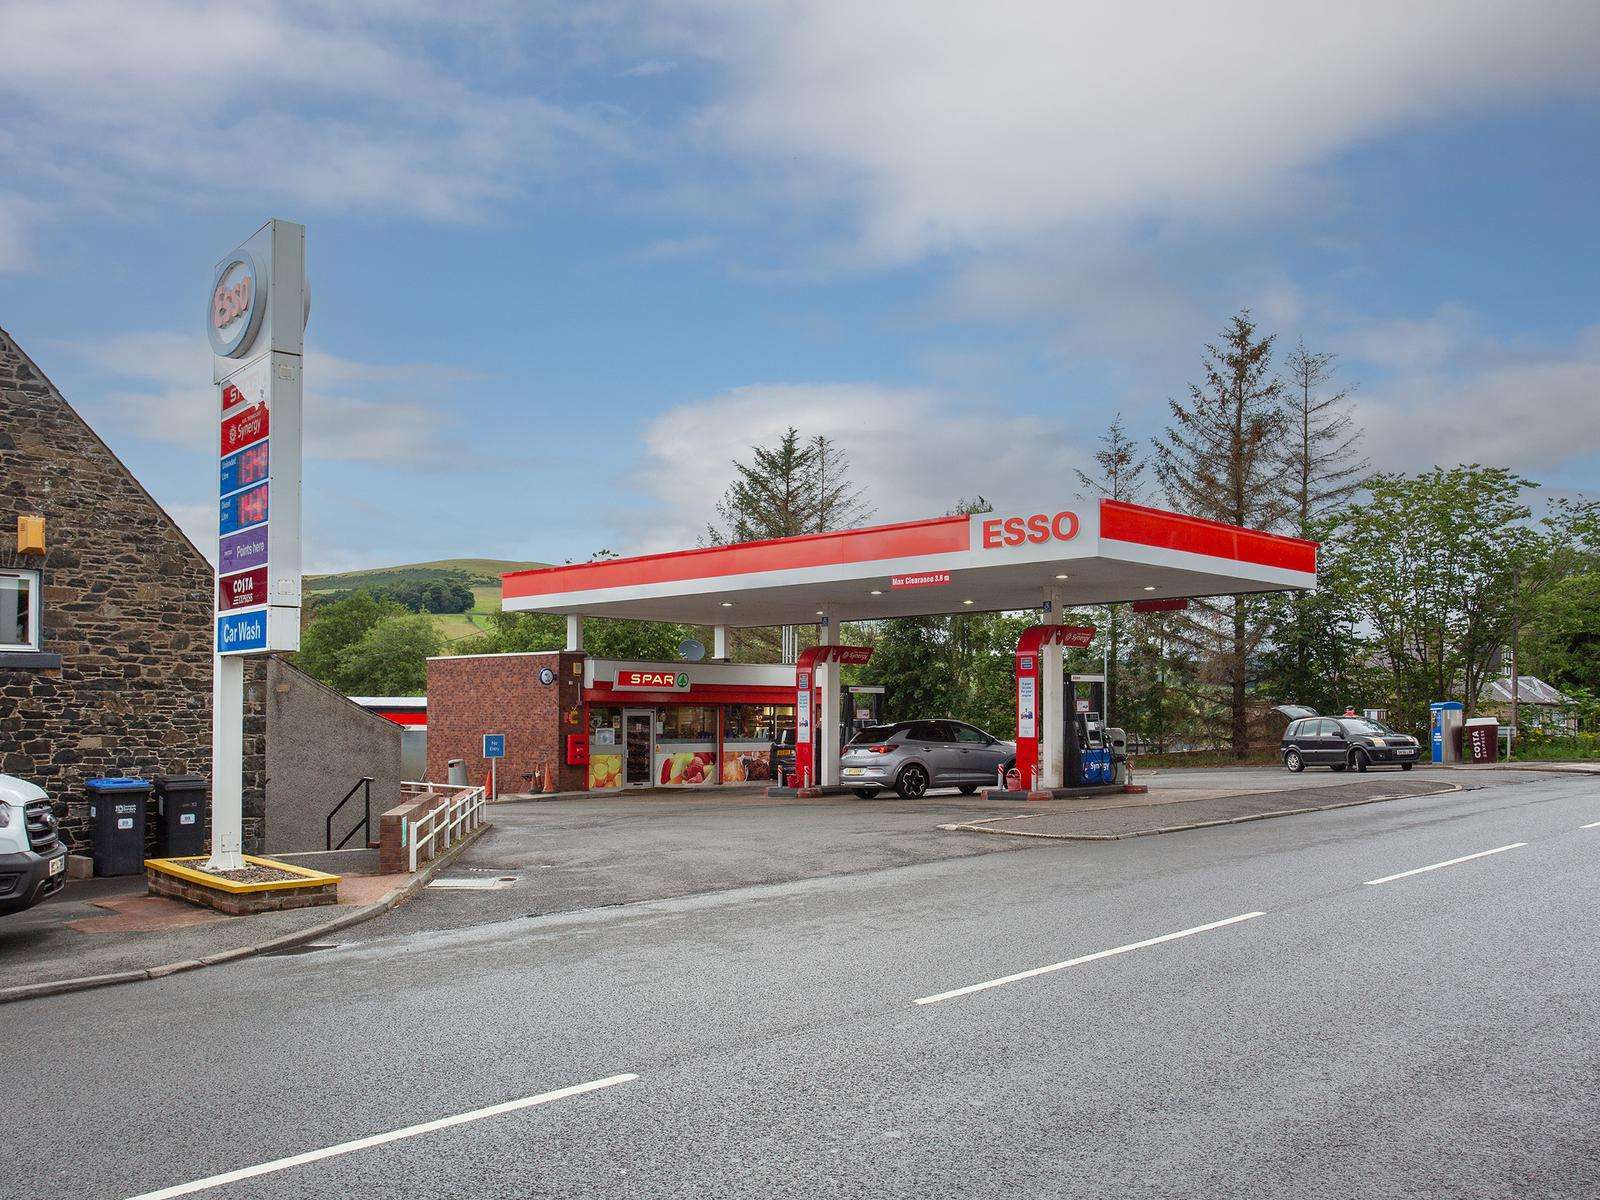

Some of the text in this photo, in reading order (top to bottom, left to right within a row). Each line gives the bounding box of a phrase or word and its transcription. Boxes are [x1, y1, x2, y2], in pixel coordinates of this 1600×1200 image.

[238, 419, 261, 441] Synergy
[982, 511, 1080, 549] ESSO
[236, 544, 252, 558] Points
[253, 541, 265, 552] here
[233, 577, 253, 594] COSTA
[223, 620, 261, 643] Car Wash
[630, 674, 674, 685] SPAR
[1472, 730, 1481, 758] COSTA
